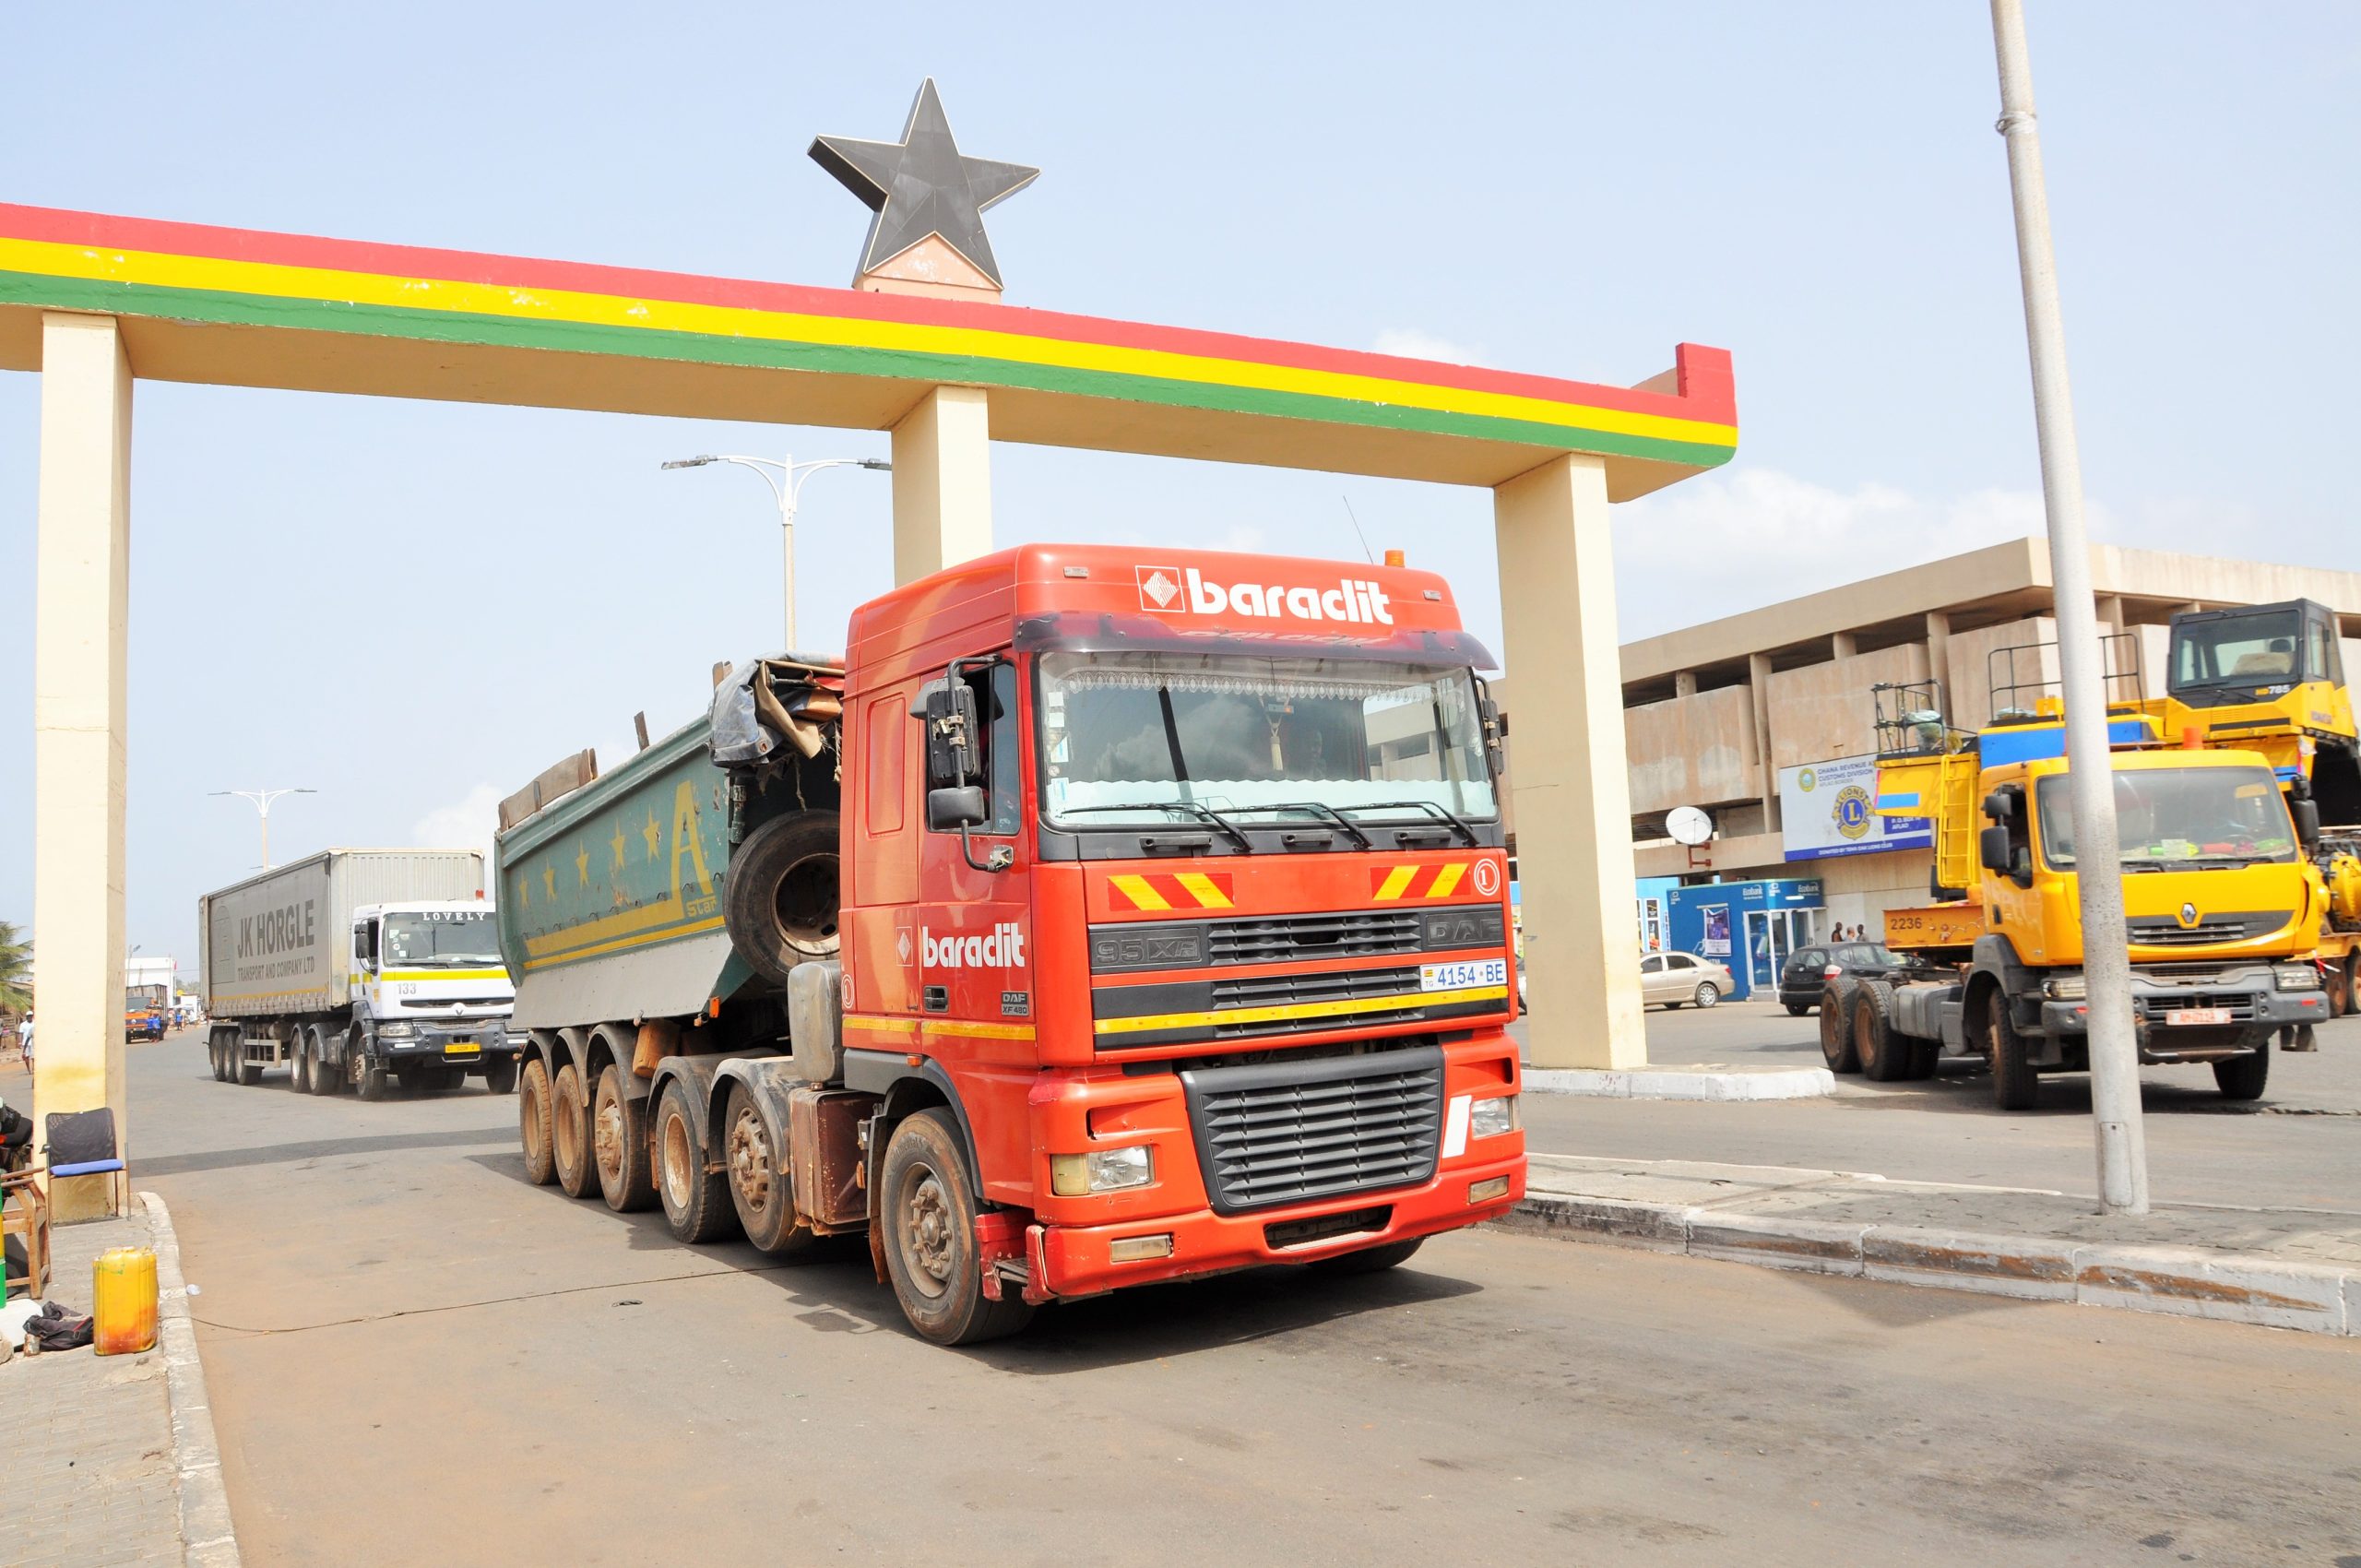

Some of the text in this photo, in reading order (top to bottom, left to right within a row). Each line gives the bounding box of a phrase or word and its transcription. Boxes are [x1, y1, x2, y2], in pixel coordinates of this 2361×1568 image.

[1819, 768, 1873, 781] CUSTOMS DIVISION
[1838, 787, 1864, 802] LIONS
[1847, 802, 1860, 822] L
[1480, 869, 1488, 885] 1
[422, 912, 486, 921] LOVELY
[237, 899, 314, 958] JK HORGLE
[1891, 918, 1922, 930] 2236
[237, 956, 314, 981] TRANSPORT AND COMPANY LTD
[1438, 966, 1476, 986] 4154
[397, 982, 417, 995] 133
[1003, 992, 1026, 1003] DAF
[1003, 1005, 1013, 1014] XF
